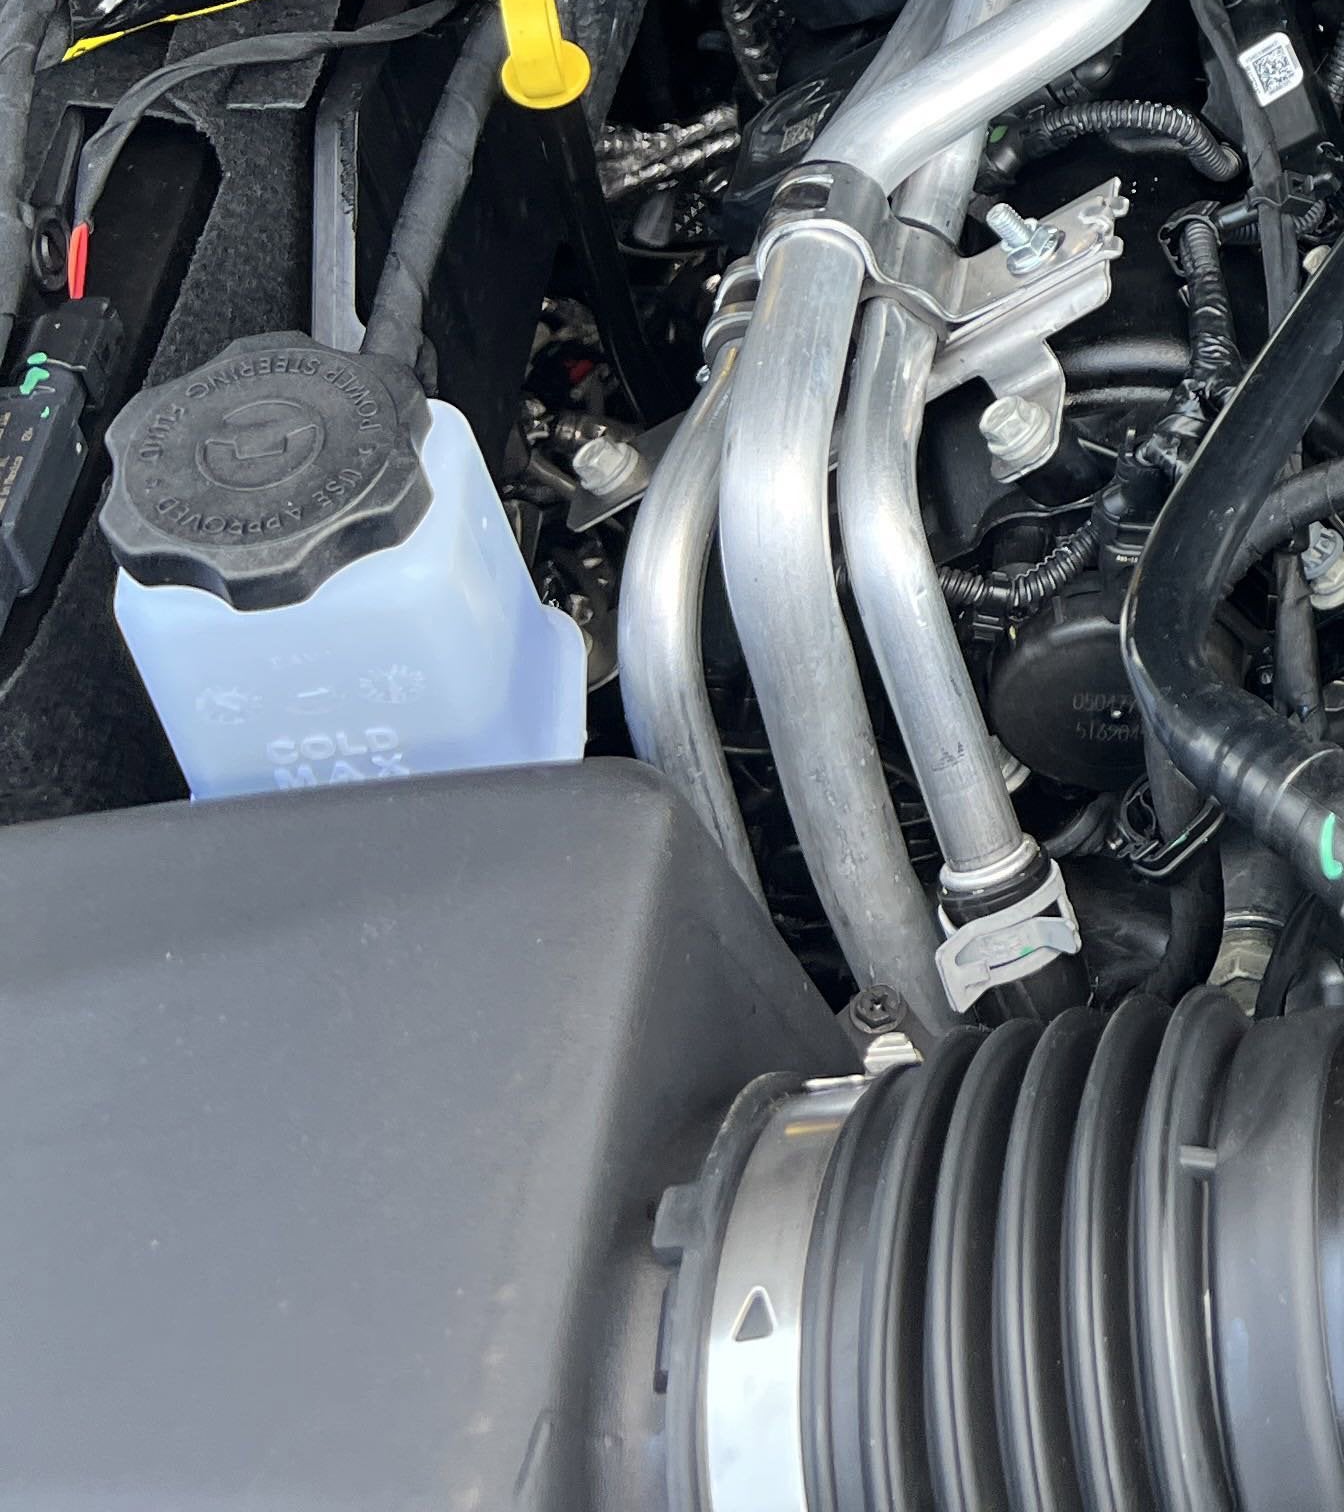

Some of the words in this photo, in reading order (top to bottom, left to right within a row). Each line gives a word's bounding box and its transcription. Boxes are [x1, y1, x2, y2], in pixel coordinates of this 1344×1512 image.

[185, 354, 322, 400] STEERING
[323, 367, 383, 434] POWER
[138, 402, 189, 462] FLUID
[312, 467, 363, 507] USE
[155, 495, 305, 537] APPROVED
[265, 723, 401, 766] COLD
[273, 751, 412, 789] MAX
